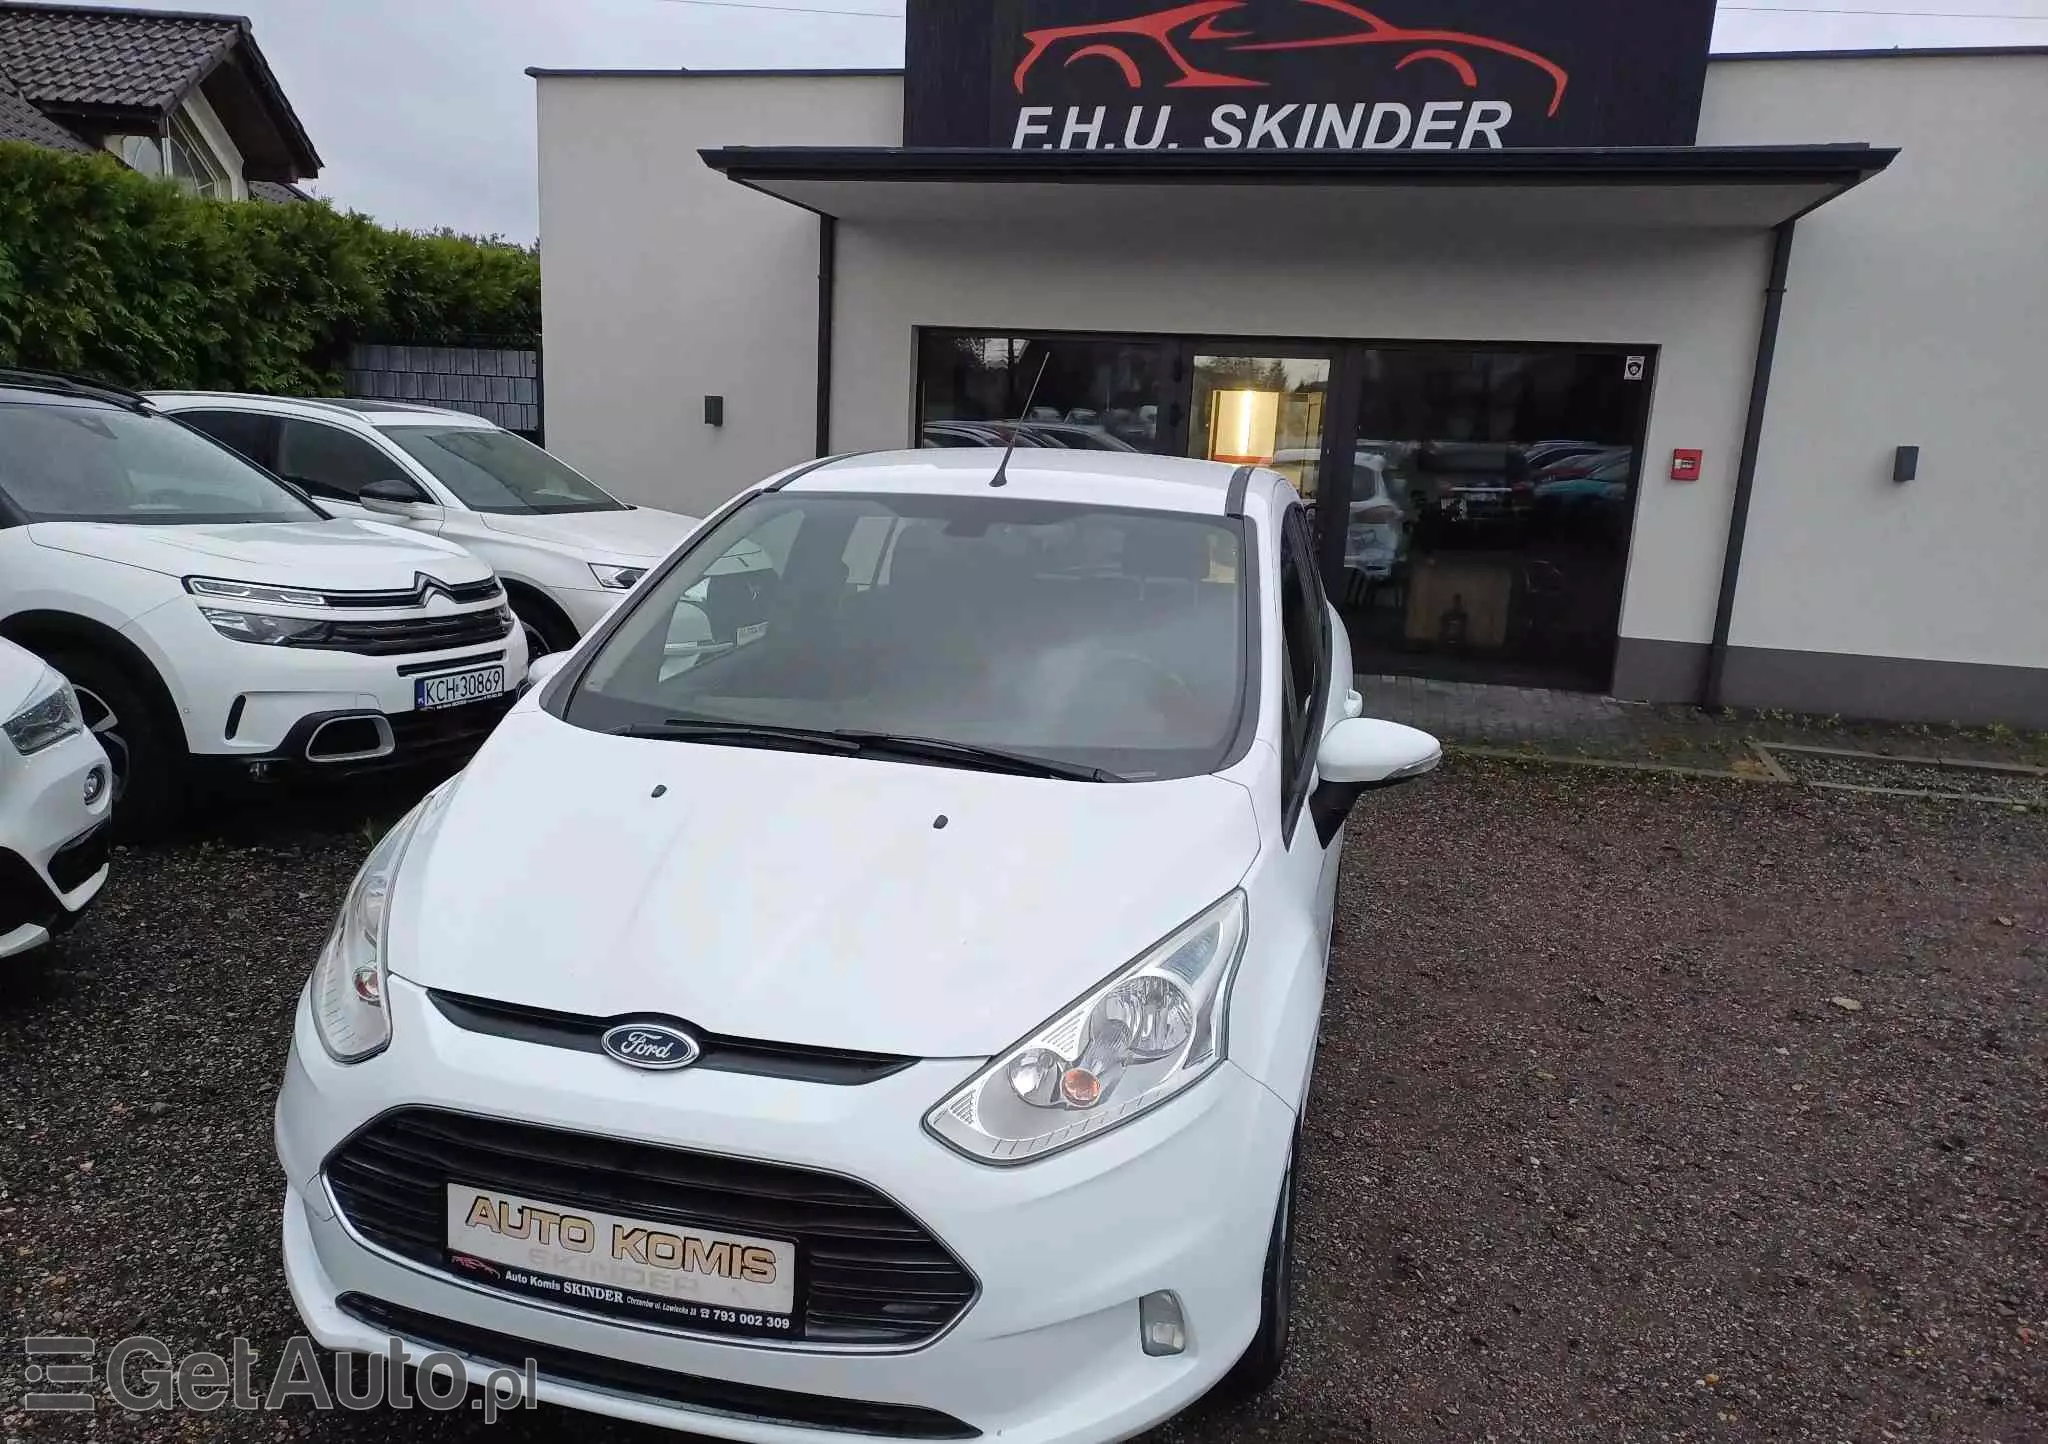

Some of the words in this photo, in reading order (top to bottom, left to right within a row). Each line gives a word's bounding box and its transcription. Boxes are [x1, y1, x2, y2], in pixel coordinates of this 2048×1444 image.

[1011, 104, 1179, 150] F.H.U.
[1203, 100, 1513, 150] SKINDER
[426, 678, 456, 704] KCH
[459, 670, 501, 698] 30869
[620, 1031, 675, 1058] Ford
[465, 1195, 596, 1254] AUTO
[611, 1223, 778, 1284] KOMIS
[505, 1270, 528, 1285] Auto
[530, 1275, 561, 1291] Komis
[563, 1280, 624, 1304] SKINDER
[712, 1309, 736, 1323] 793
[739, 1313, 763, 1326] 002
[766, 1316, 790, 1329] 309
